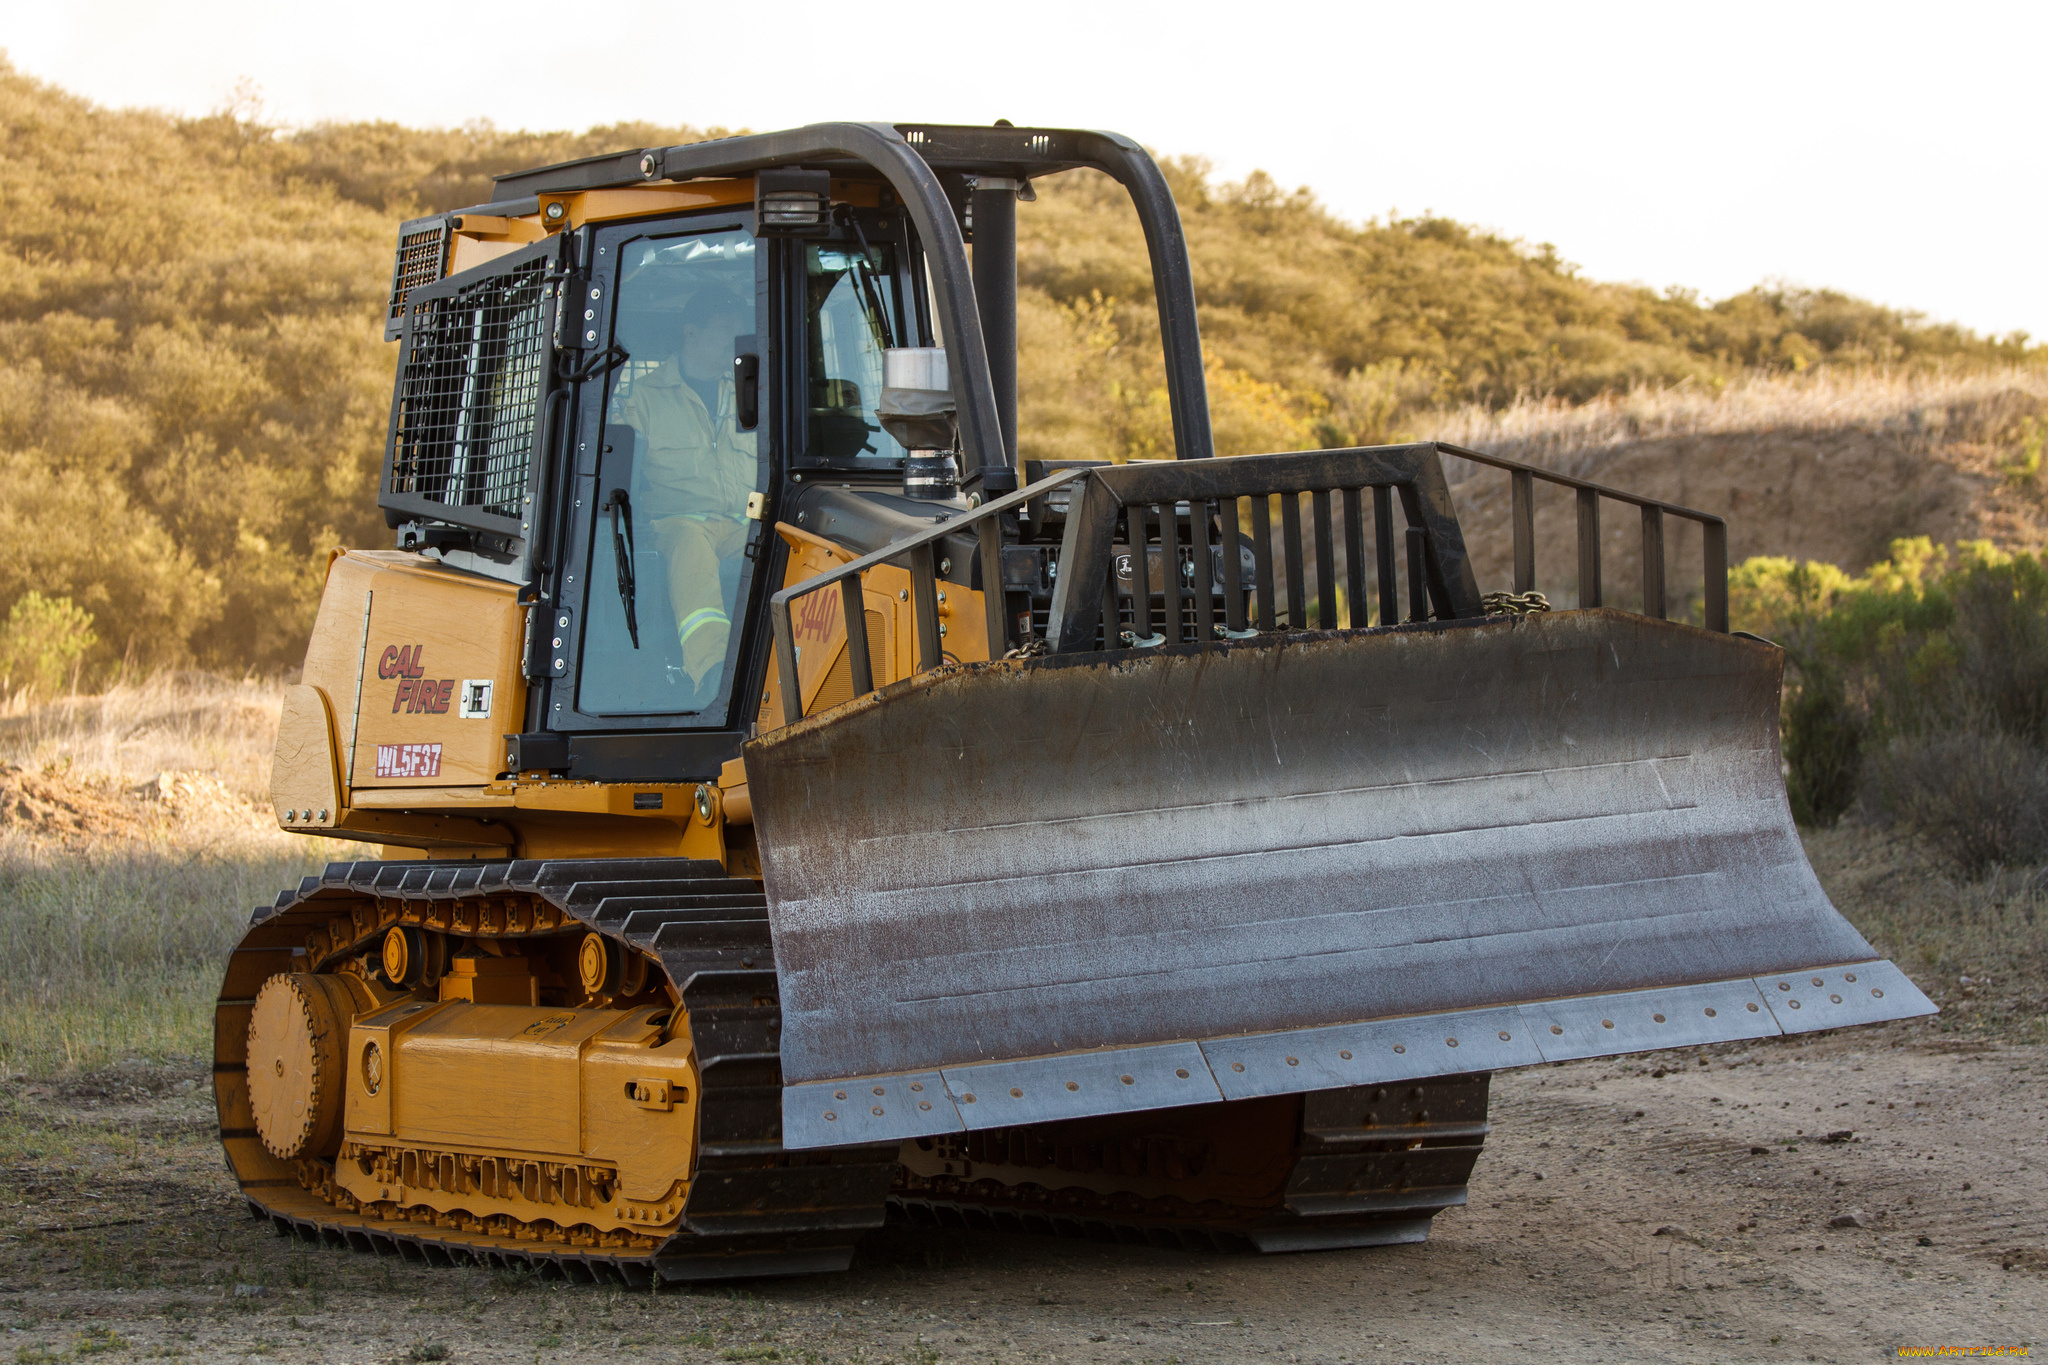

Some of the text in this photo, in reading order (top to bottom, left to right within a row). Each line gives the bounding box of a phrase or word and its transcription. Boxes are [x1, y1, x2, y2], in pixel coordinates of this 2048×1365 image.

[795, 588, 838, 644] 3440
[378, 645, 425, 680] CAL
[392, 679, 455, 714] FIRE
[377, 744, 442, 777] WL5F37
